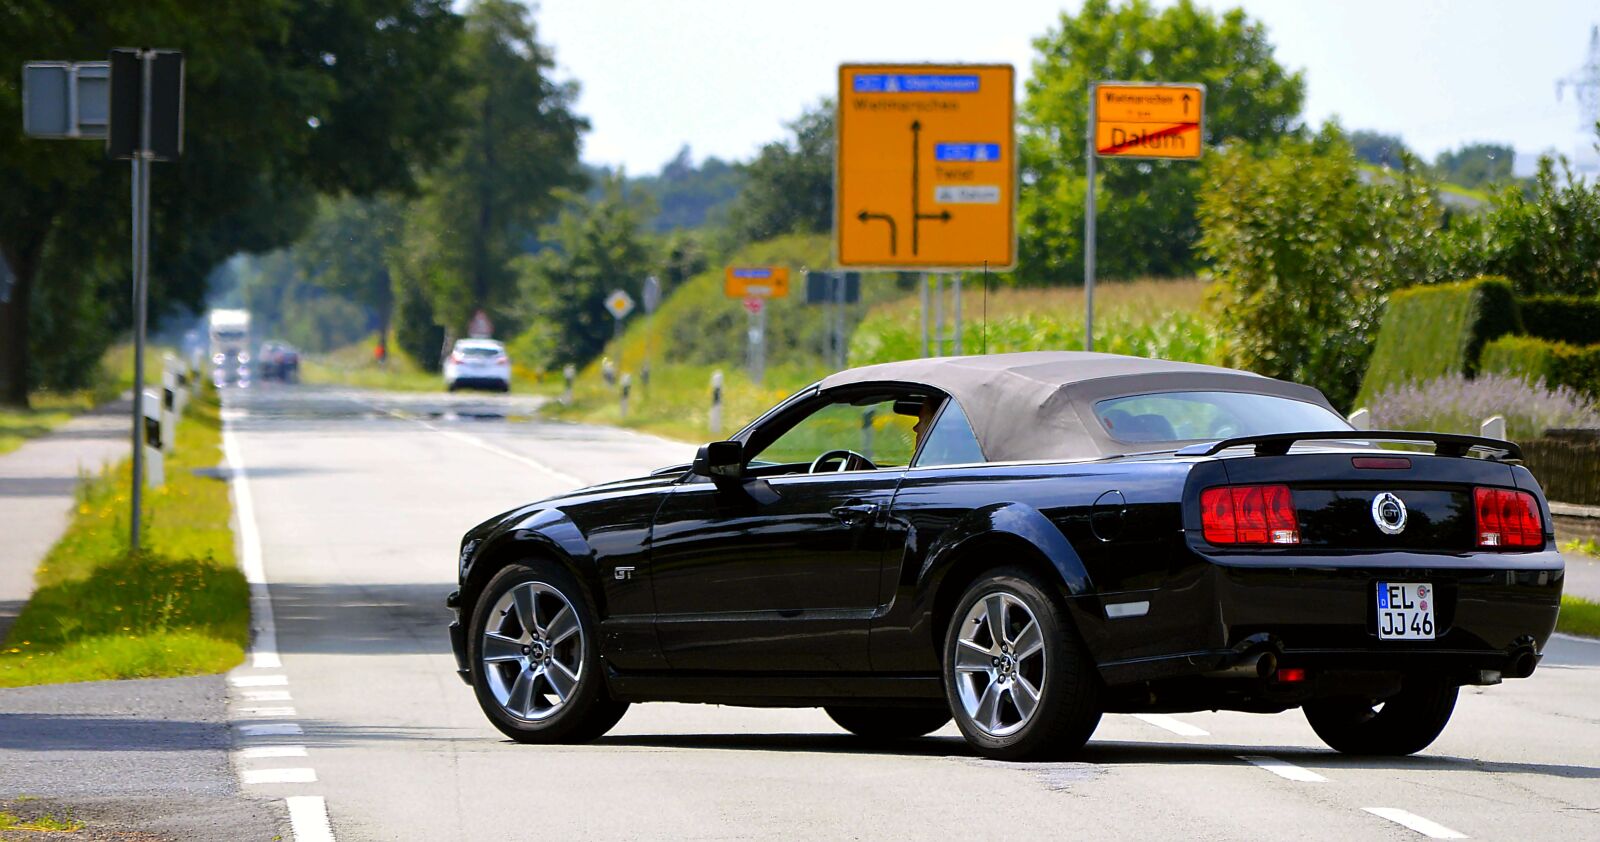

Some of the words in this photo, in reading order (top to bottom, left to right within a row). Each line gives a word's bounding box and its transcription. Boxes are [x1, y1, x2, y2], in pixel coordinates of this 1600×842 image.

[1383, 509, 1398, 517] GT
[614, 566, 635, 580] GT
[1389, 586, 1414, 609] EL
[1382, 612, 1406, 635] JJ
[1410, 612, 1433, 635] 46
